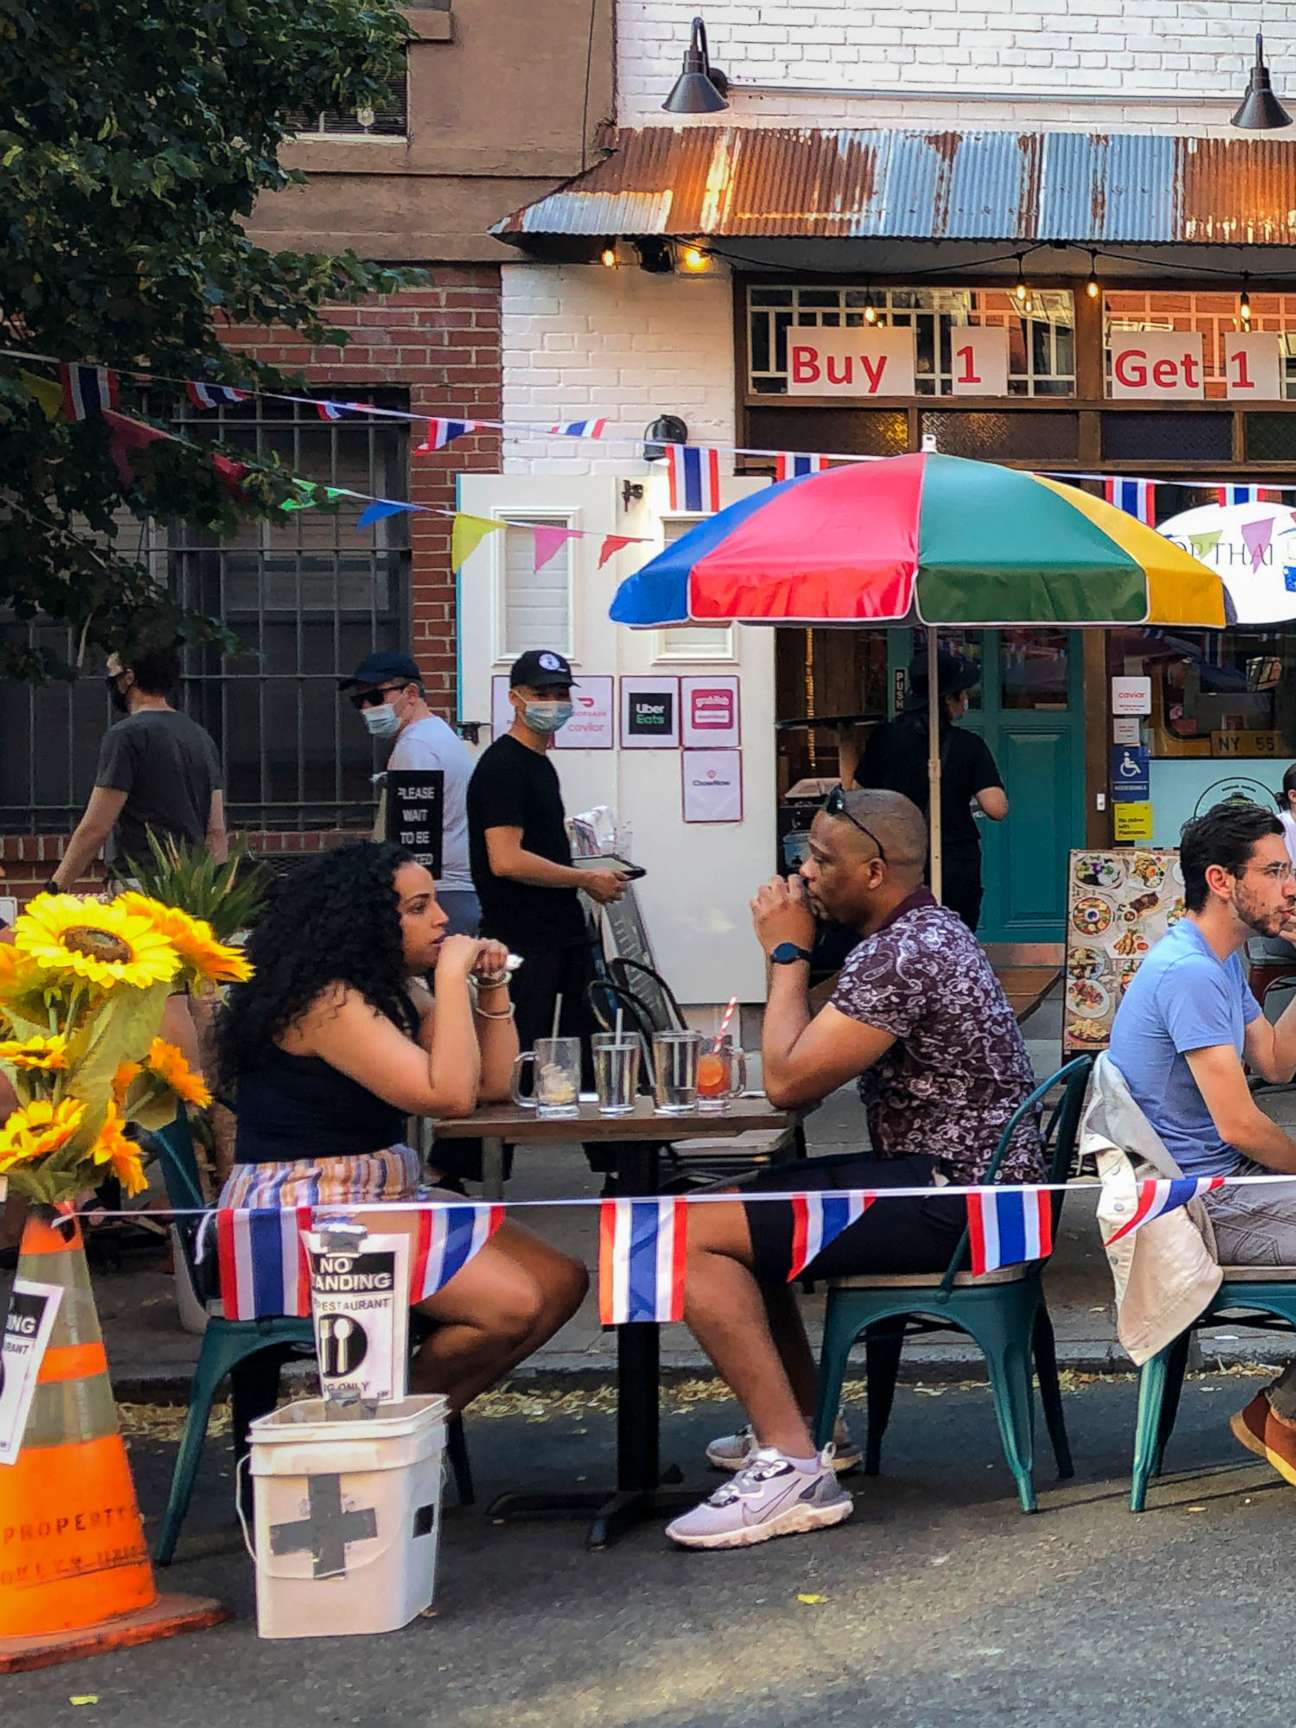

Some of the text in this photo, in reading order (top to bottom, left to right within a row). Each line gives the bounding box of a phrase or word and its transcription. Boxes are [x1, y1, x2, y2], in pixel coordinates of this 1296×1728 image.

[792, 346, 981, 394] Buy 1
[1115, 349, 1255, 388] Get 1
[1210, 541, 1274, 567] THAI
[896, 671, 904, 709] PUSH
[636, 703, 665, 714] Uber
[636, 714, 665, 724] Eats
[397, 786, 435, 800] PLEASE
[401, 809, 429, 822] WAIT
[400, 831, 431, 844] TO BE
[320, 1257, 352, 1274] NO
[313, 1271, 393, 1291] ANDING
